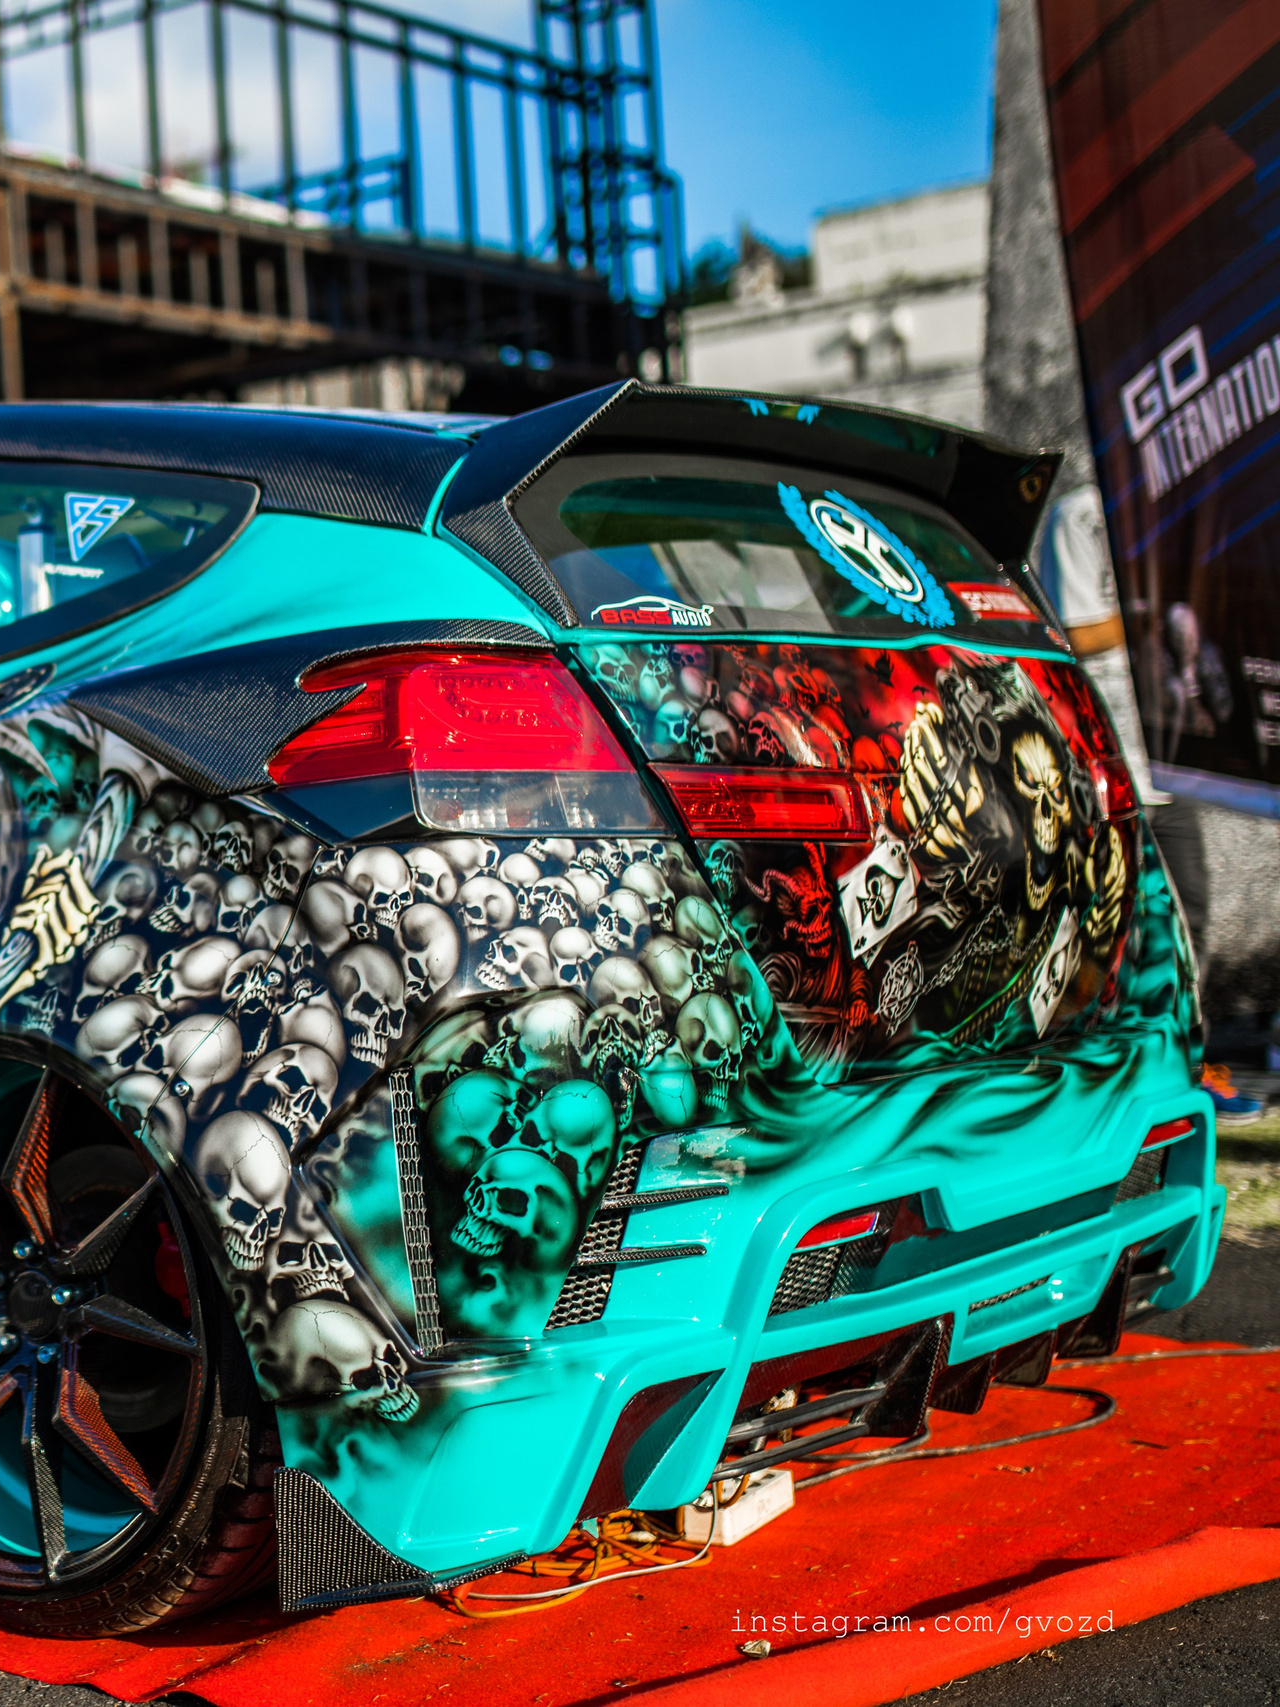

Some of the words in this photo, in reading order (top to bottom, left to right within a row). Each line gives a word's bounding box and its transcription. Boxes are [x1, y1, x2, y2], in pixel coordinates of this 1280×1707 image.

[1121, 325, 1209, 444] GO
[600, 609, 672, 625] BASS
[672, 610, 711, 626] AUDIO
